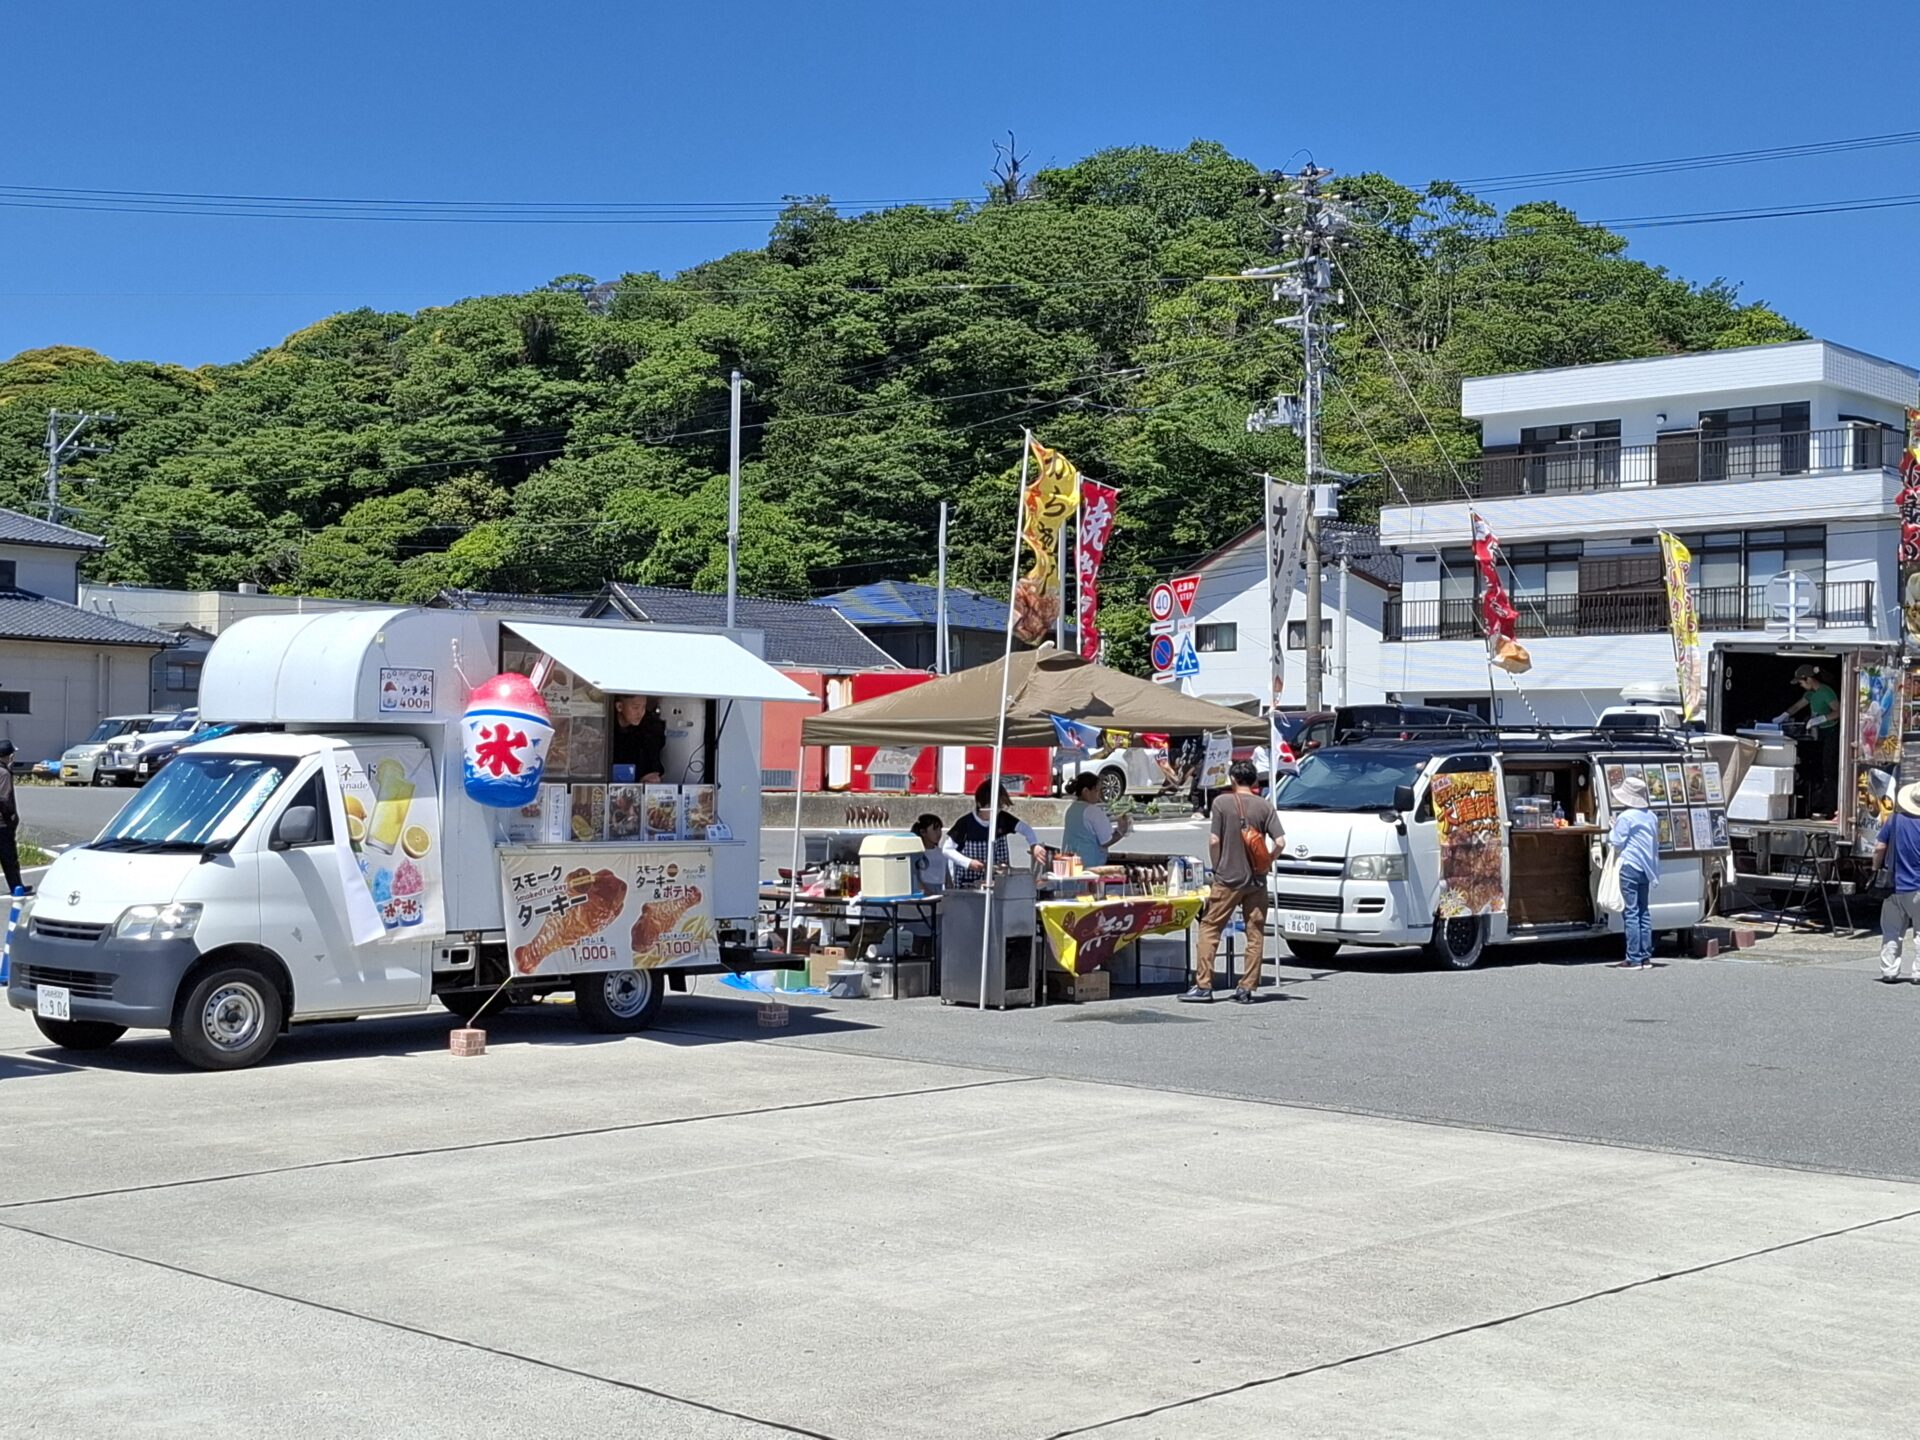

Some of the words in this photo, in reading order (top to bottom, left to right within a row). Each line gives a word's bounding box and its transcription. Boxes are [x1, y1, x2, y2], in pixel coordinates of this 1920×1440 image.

[1155, 594, 1169, 610] 40
[400, 697, 430, 709] 400円
[475, 722, 529, 778] 氷
[337, 763, 377, 781] ネード
[636, 865, 665, 874] スモーク
[512, 865, 562, 892] スモーク
[636, 875, 676, 889] ターキー
[384, 903, 396, 918] 氷
[401, 899, 417, 914] 氷
[518, 894, 588, 928] ターキー
